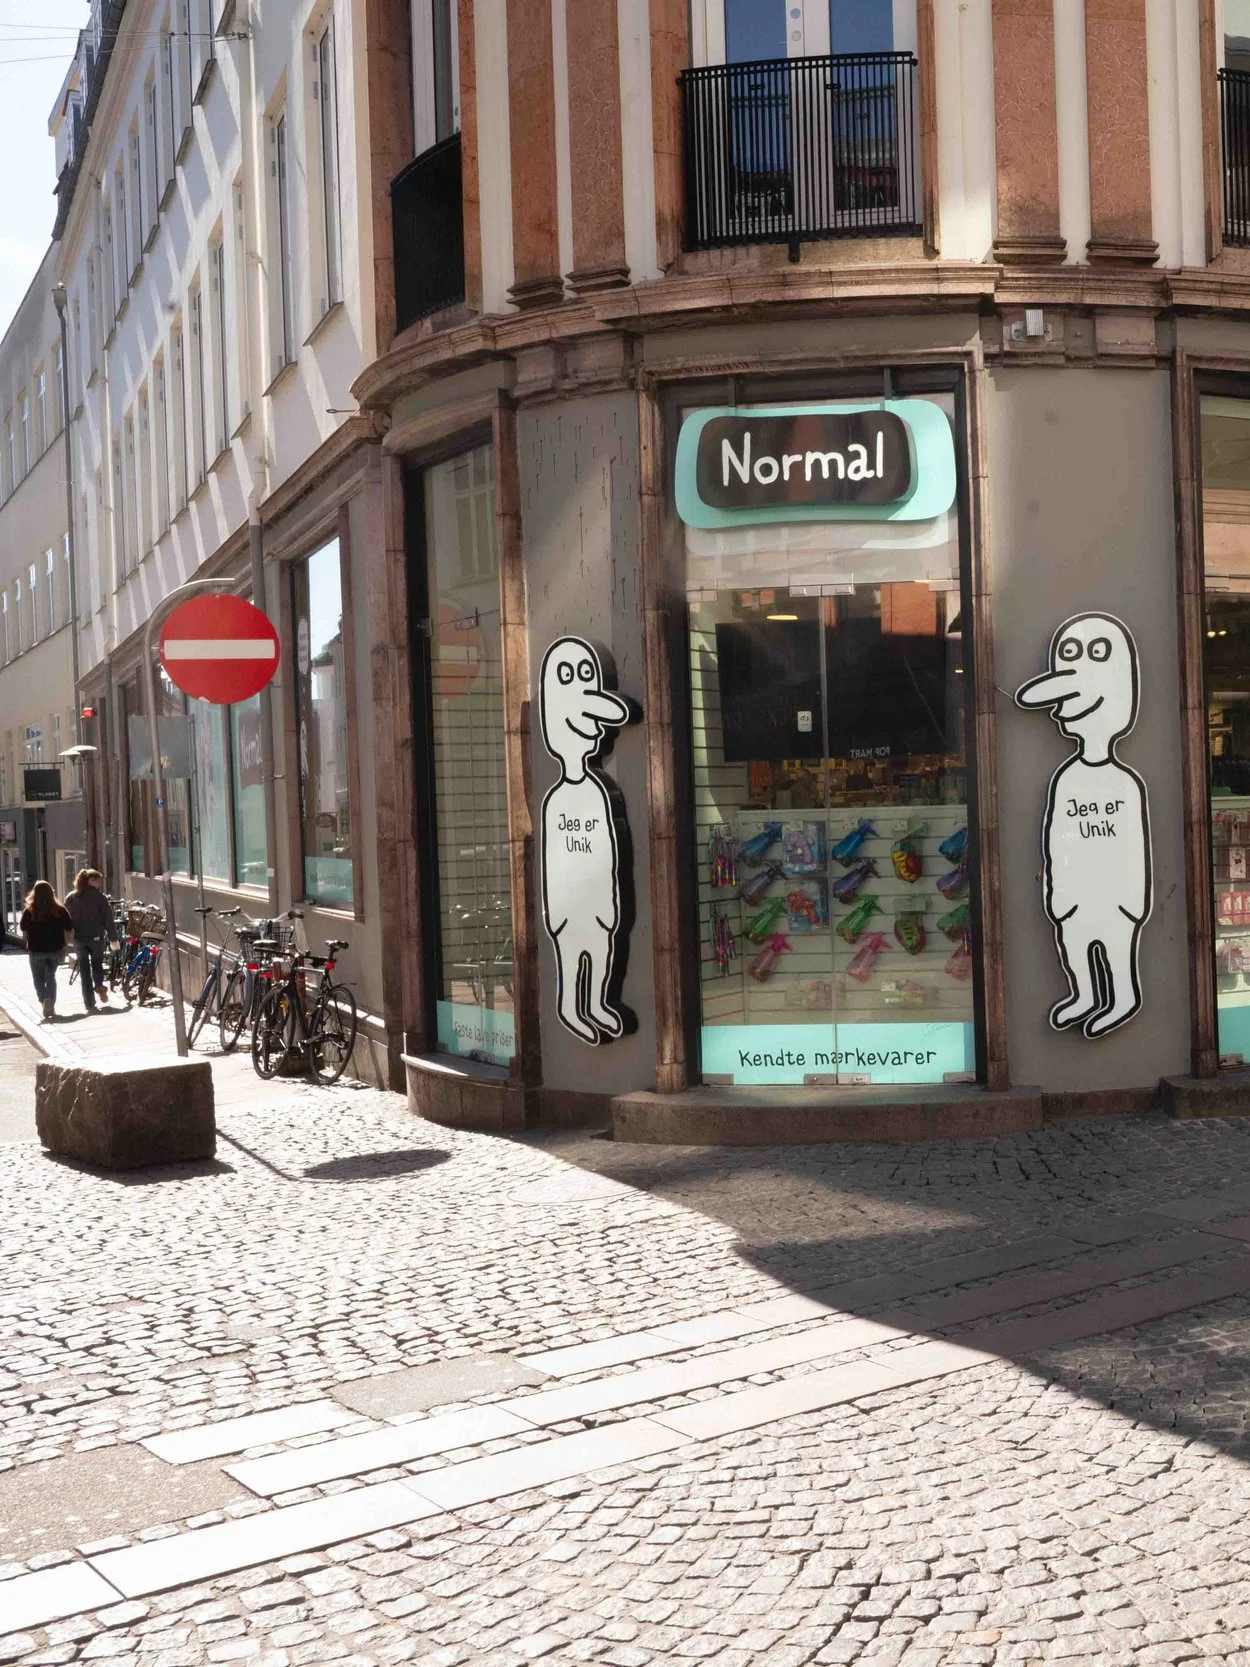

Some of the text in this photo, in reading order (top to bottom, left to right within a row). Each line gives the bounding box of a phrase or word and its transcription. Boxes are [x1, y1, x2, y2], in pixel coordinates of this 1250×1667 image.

[721, 431, 884, 487] Normal
[1105, 800, 1125, 815] er
[558, 814, 599, 832] Jeg er
[1079, 820, 1117, 839] Unik
[566, 836, 592, 853] Unik
[738, 1047, 937, 1068] Kendte mærkevarer
